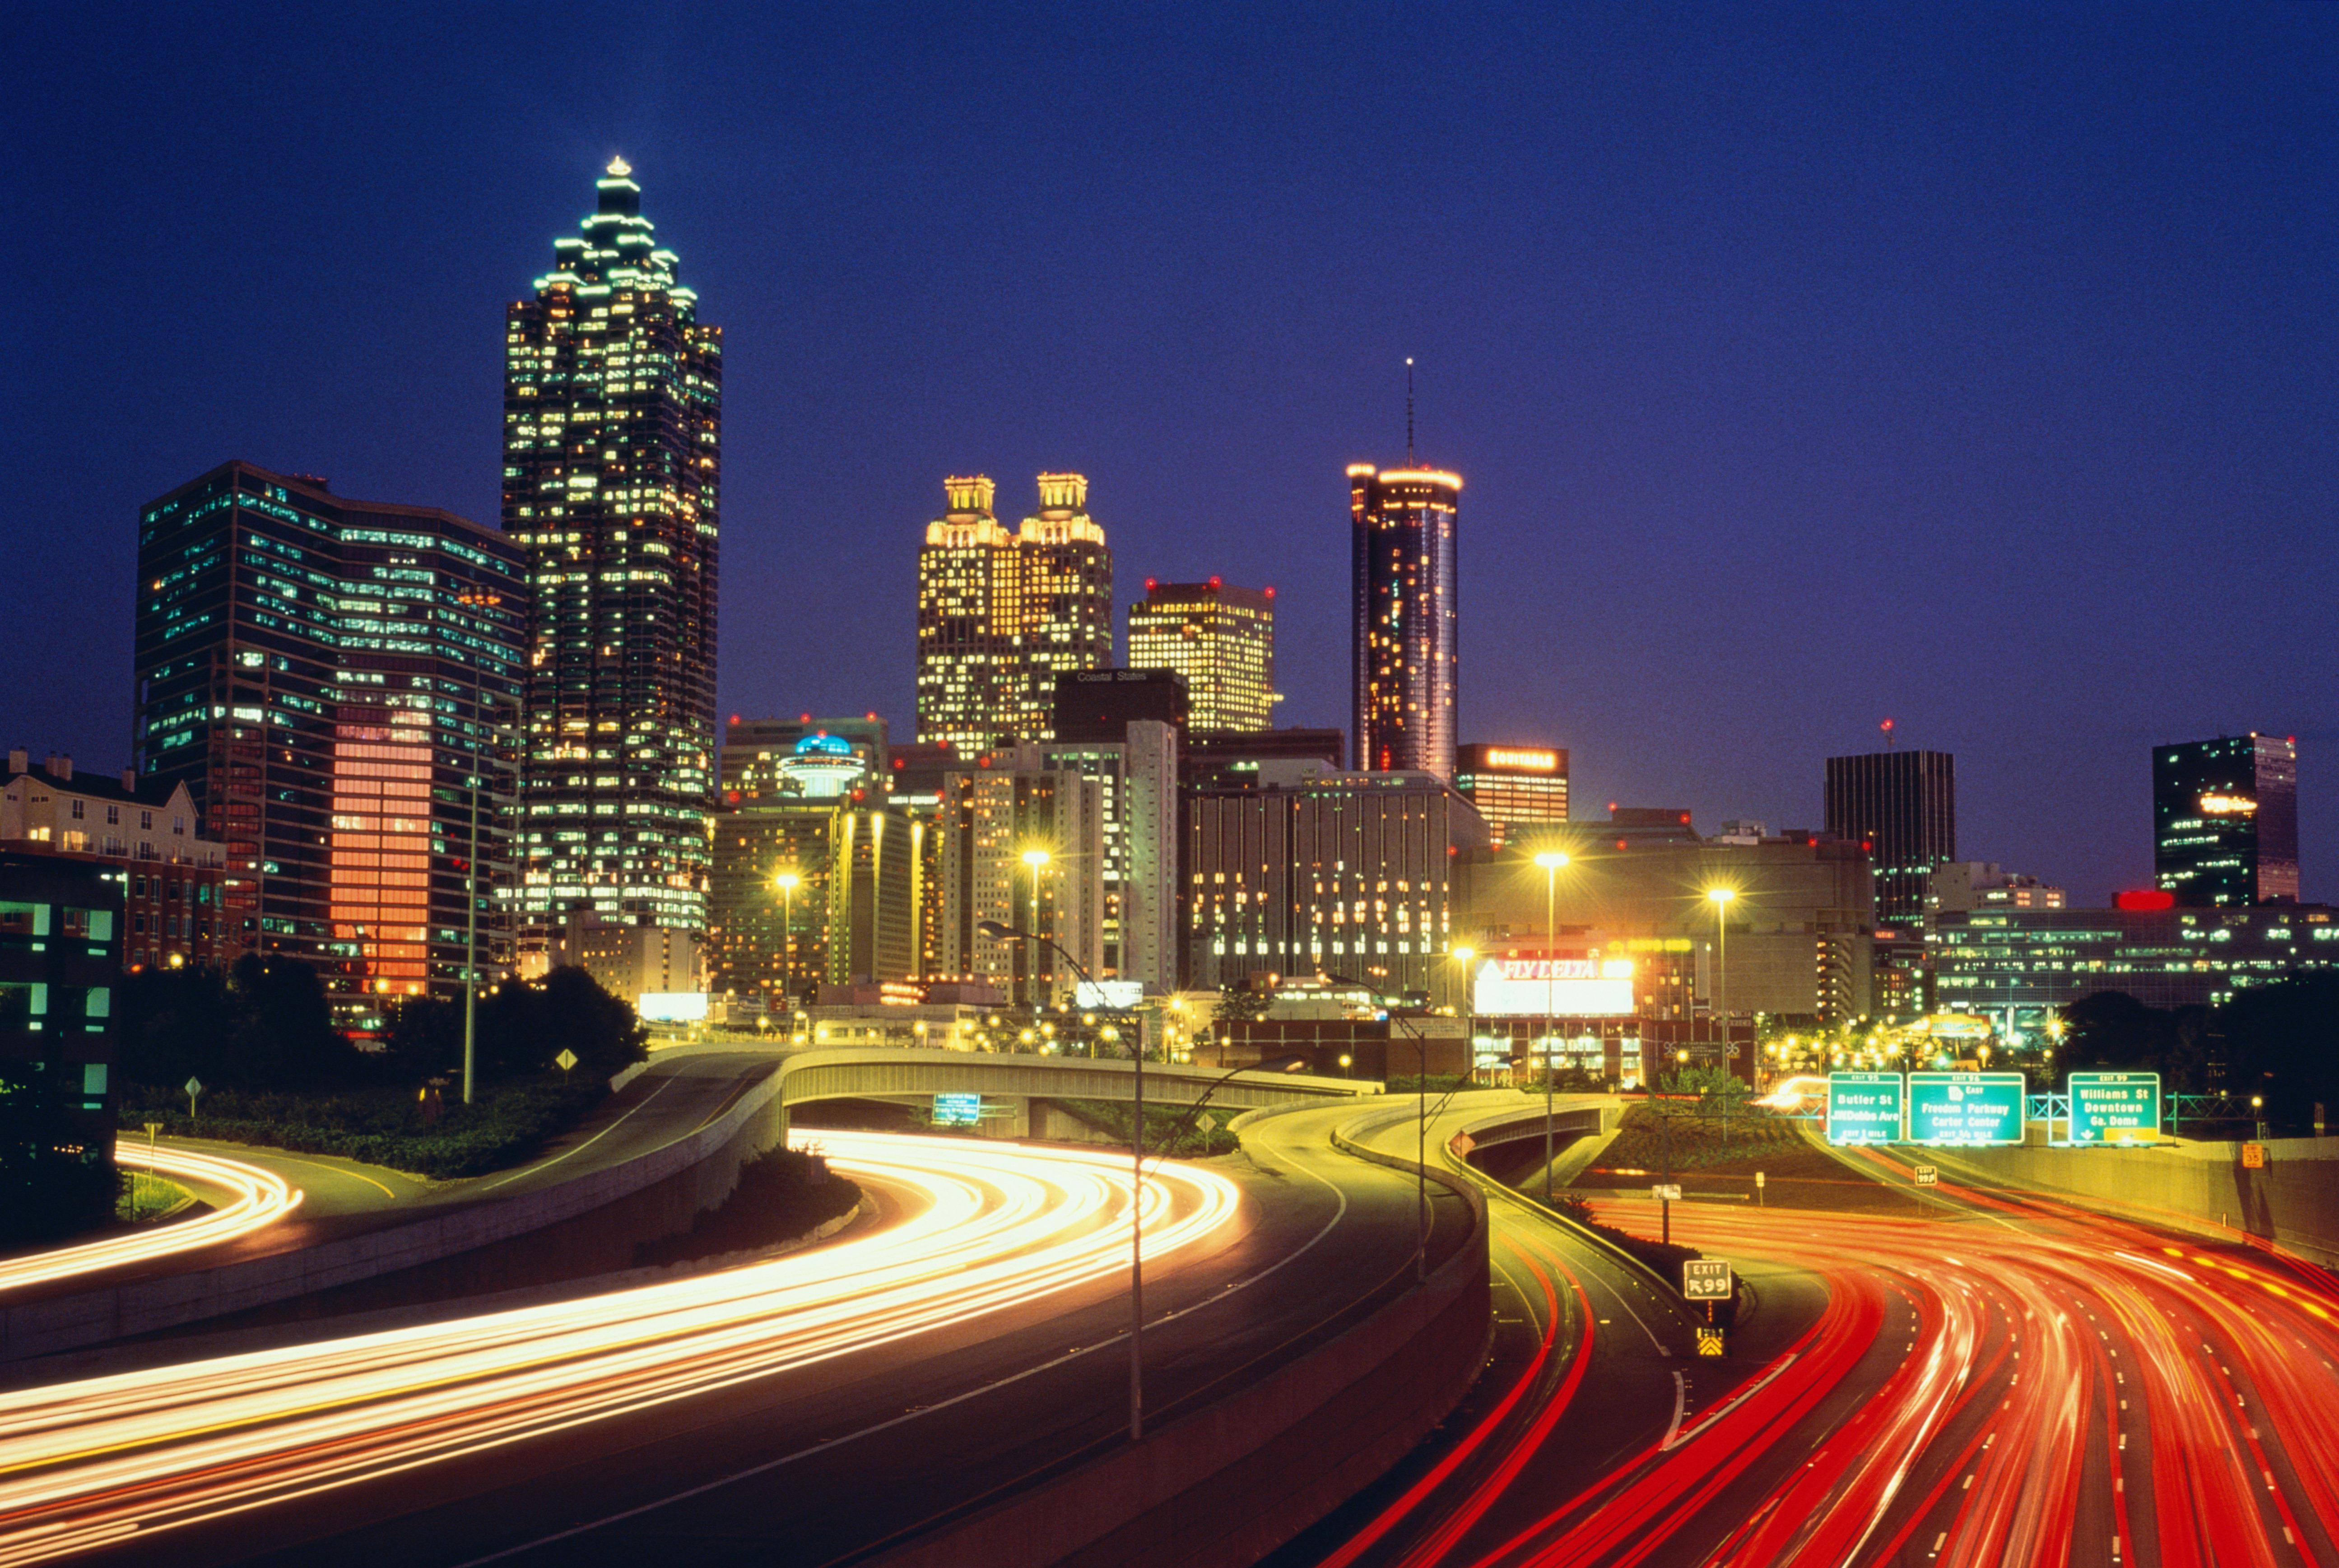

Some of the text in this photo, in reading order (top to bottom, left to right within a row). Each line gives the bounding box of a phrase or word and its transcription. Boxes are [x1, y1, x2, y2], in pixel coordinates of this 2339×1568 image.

[1078, 671, 1147, 682] Coastal States
[1489, 750, 1553, 767] EQUITABLE
[1504, 960, 1597, 979] FLY DELTA
[1726, 1041, 1740, 1055] 96
[1965, 1086, 1984, 1094] EAST
[2080, 1089, 2148, 1099] Williams St
[1837, 1094, 1892, 1105] Butler St
[1922, 1103, 2009, 1116] Freedom Parkway
[2084, 1102, 2143, 1113] Downtown
[1879, 1112, 1899, 1121] Ave
[1932, 1117, 2000, 1127] Carter Center
[2090, 1116, 2138, 1126] Ga. Dome
[1693, 1265, 1721, 1275] EXIT
[1704, 1279, 1726, 1293] 99
